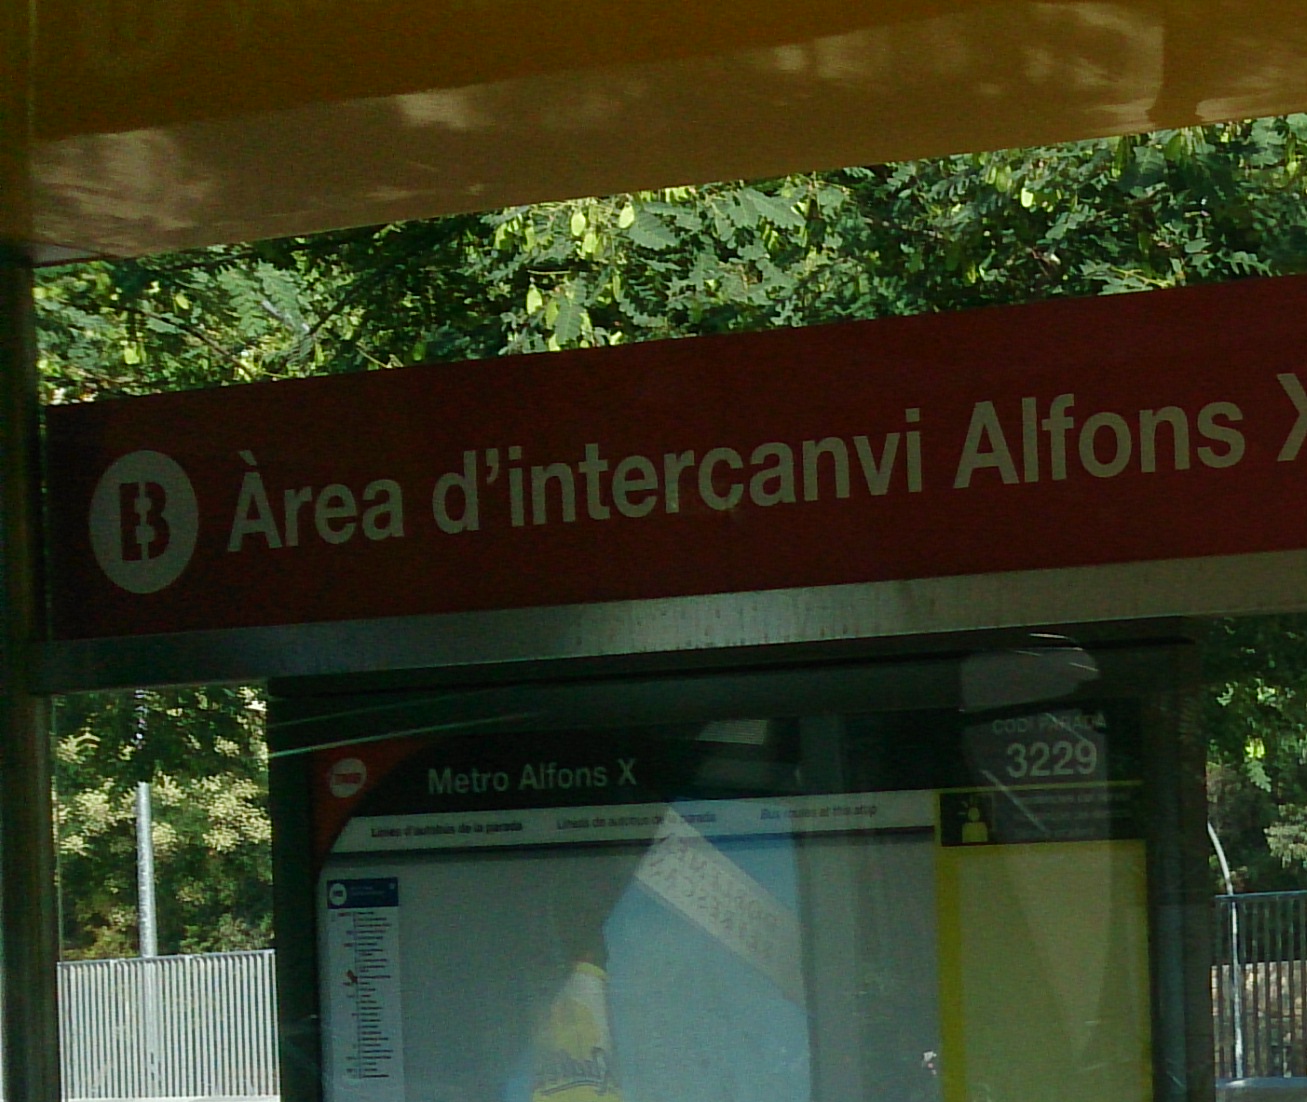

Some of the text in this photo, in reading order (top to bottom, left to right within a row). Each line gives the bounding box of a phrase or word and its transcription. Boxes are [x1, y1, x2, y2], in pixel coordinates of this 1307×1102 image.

[228, 450, 404, 553] Àrea
[953, 392, 1247, 489] Alfons
[428, 758, 638, 795] Metro Alfons X
[1006, 741, 1097, 778] 3229
